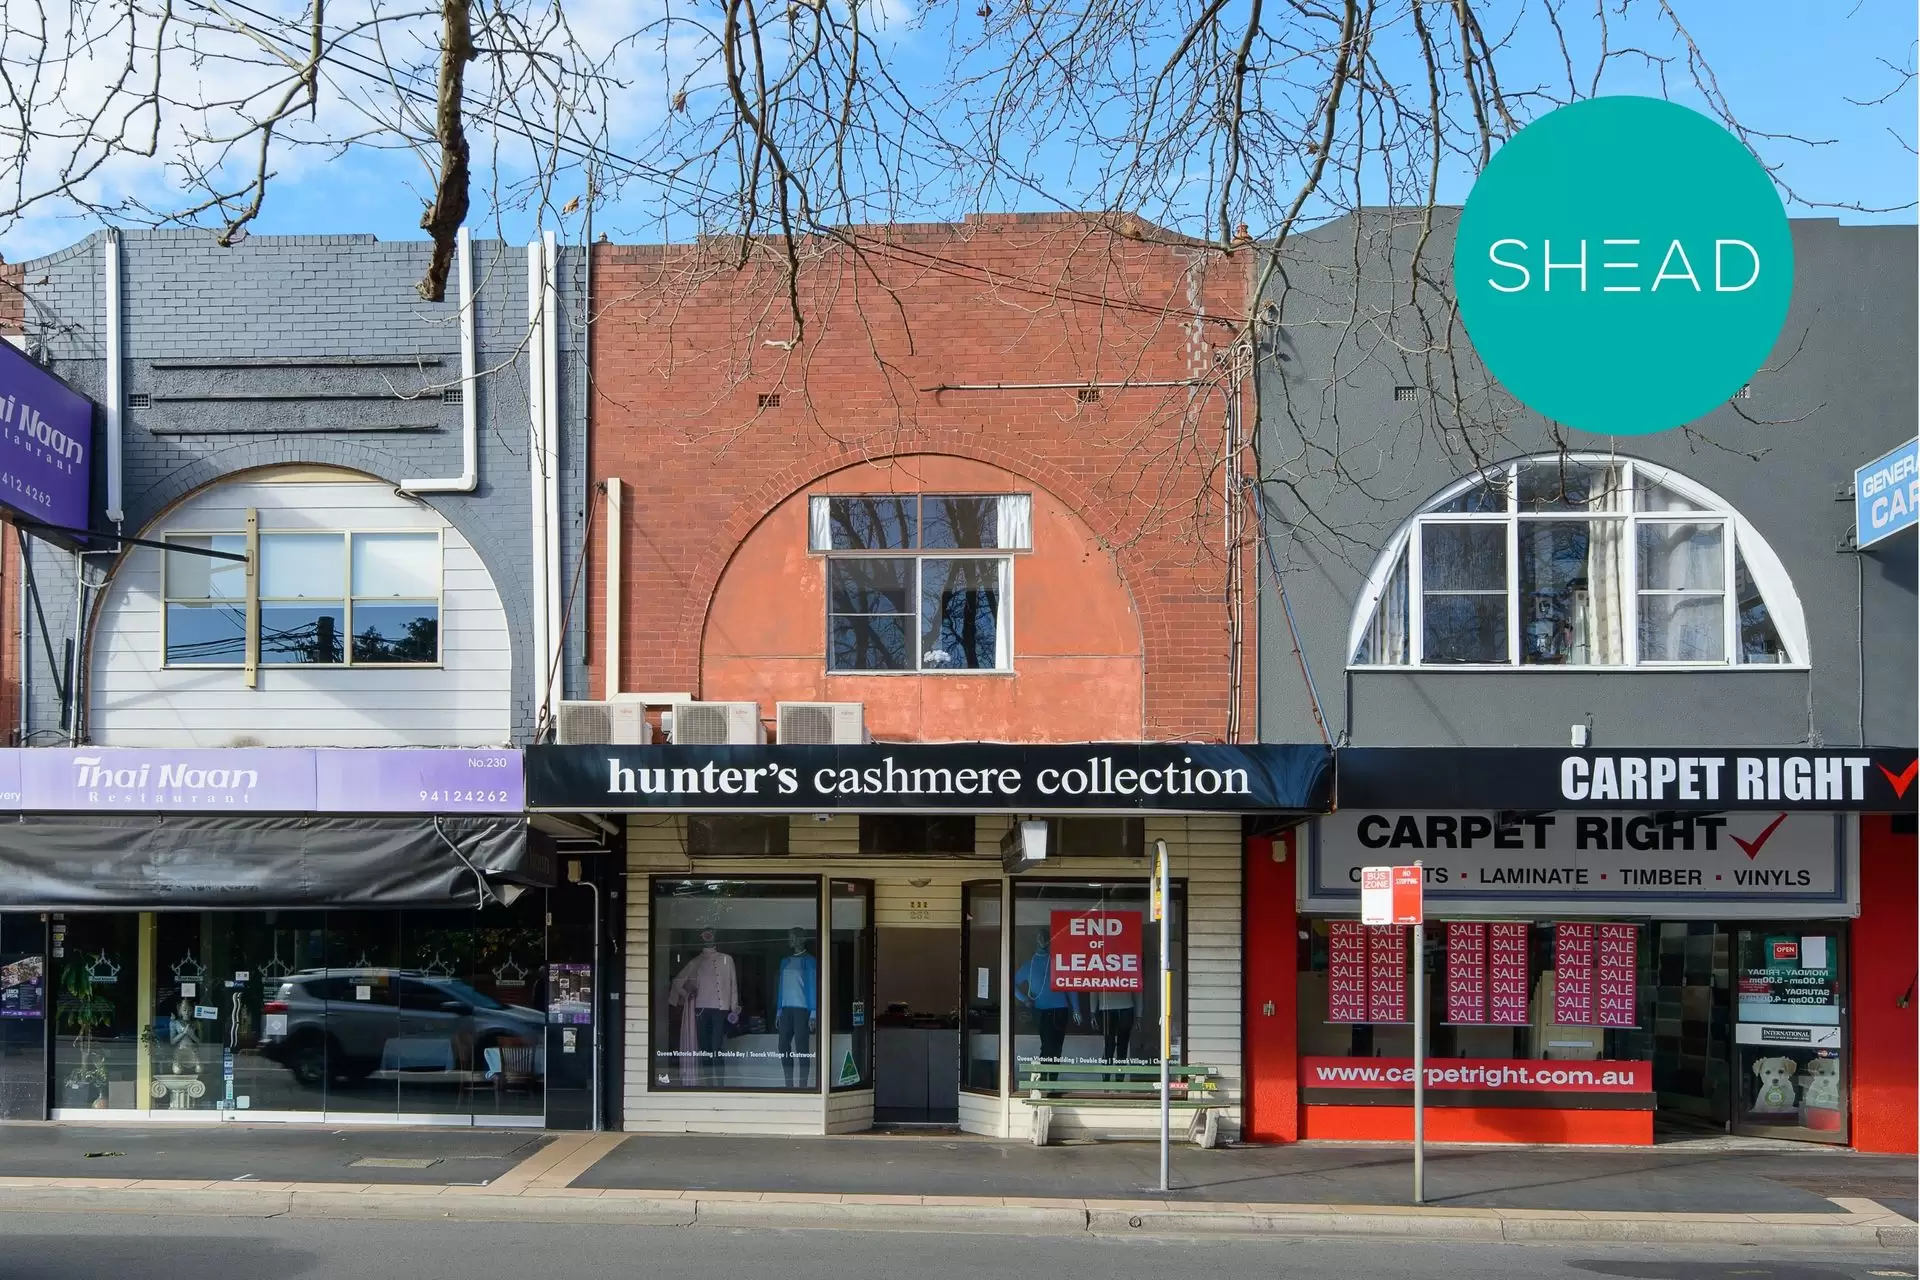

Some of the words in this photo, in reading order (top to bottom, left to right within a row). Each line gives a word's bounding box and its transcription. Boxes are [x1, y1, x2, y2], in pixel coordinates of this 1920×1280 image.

[18, 404, 83, 465] Naan
[1862, 454, 1919, 498] GENER
[468, 757, 507, 768] No.230
[72, 756, 151, 788] Thai
[158, 763, 258, 789] Naan
[607, 757, 799, 794] hunter's
[813, 757, 1021, 794] cashmere
[1036, 757, 1252, 794] collection
[1560, 756, 1726, 801] CARPET
[1736, 756, 1871, 801] RIGHT
[88, 791, 249, 803] Restaurant
[419, 790, 508, 802] 94124262
[1357, 814, 1556, 849] CARPET
[1576, 816, 1727, 851] RIGHT
[1367, 872, 1386, 880] BUS
[1480, 868, 1589, 884] LAMINATE
[1619, 868, 1703, 886] TIMBER
[1733, 869, 1811, 886] VINYLS
[1364, 880, 1389, 888] ZONE
[1070, 918, 1123, 936] END
[1332, 924, 1364, 935] SALE
[1371, 925, 1404, 935] SALE
[1450, 925, 1483, 936] SALE
[1493, 925, 1525, 937] SALE
[1559, 925, 1591, 937] SALE
[1602, 927, 1634, 939] SALE
[1089, 940, 1104, 949] OF
[1332, 938, 1364, 949] SALE
[1371, 939, 1404, 949] SALE
[1450, 939, 1483, 950] SALE
[1493, 940, 1525, 951] SALE
[1559, 940, 1591, 952] SALE
[1601, 941, 1634, 953] SALE
[1055, 953, 1138, 972] LEASE
[1332, 952, 1364, 963] SALE
[1371, 953, 1404, 964] SALE
[1450, 953, 1483, 964] SALE
[1493, 954, 1525, 965] SALE
[1559, 954, 1591, 966] SALE
[1601, 955, 1634, 967] SALE
[1332, 966, 1364, 977] SALE
[1371, 967, 1404, 978] SALE
[1450, 967, 1483, 979] SALE
[1493, 968, 1525, 979] SALE
[1558, 968, 1591, 980] SALE
[1601, 970, 1633, 981] SALE
[1055, 977, 1138, 987] CLEARANCE
[1332, 980, 1364, 991] SALE
[1371, 981, 1404, 992] SALE
[1450, 981, 1483, 993] SALE
[1493, 982, 1525, 993] SALE
[1558, 982, 1590, 994] SALE
[1600, 983, 1633, 996] SALE
[1332, 994, 1364, 1006] SALE
[1371, 995, 1404, 1006] SALE
[1450, 996, 1483, 1007] SALE
[1493, 996, 1525, 1008] SALE
[1558, 996, 1590, 1008] SALE
[1600, 998, 1633, 1010] SALE
[1332, 1009, 1364, 1020] SALE
[1371, 1009, 1404, 1020] SALE
[1450, 1010, 1483, 1021] SALE
[1493, 1010, 1525, 1022] SALE
[1558, 1011, 1590, 1023] SALE
[1600, 1012, 1632, 1024] SALE
[1763, 1029, 1810, 1037] INTERNATIONAL
